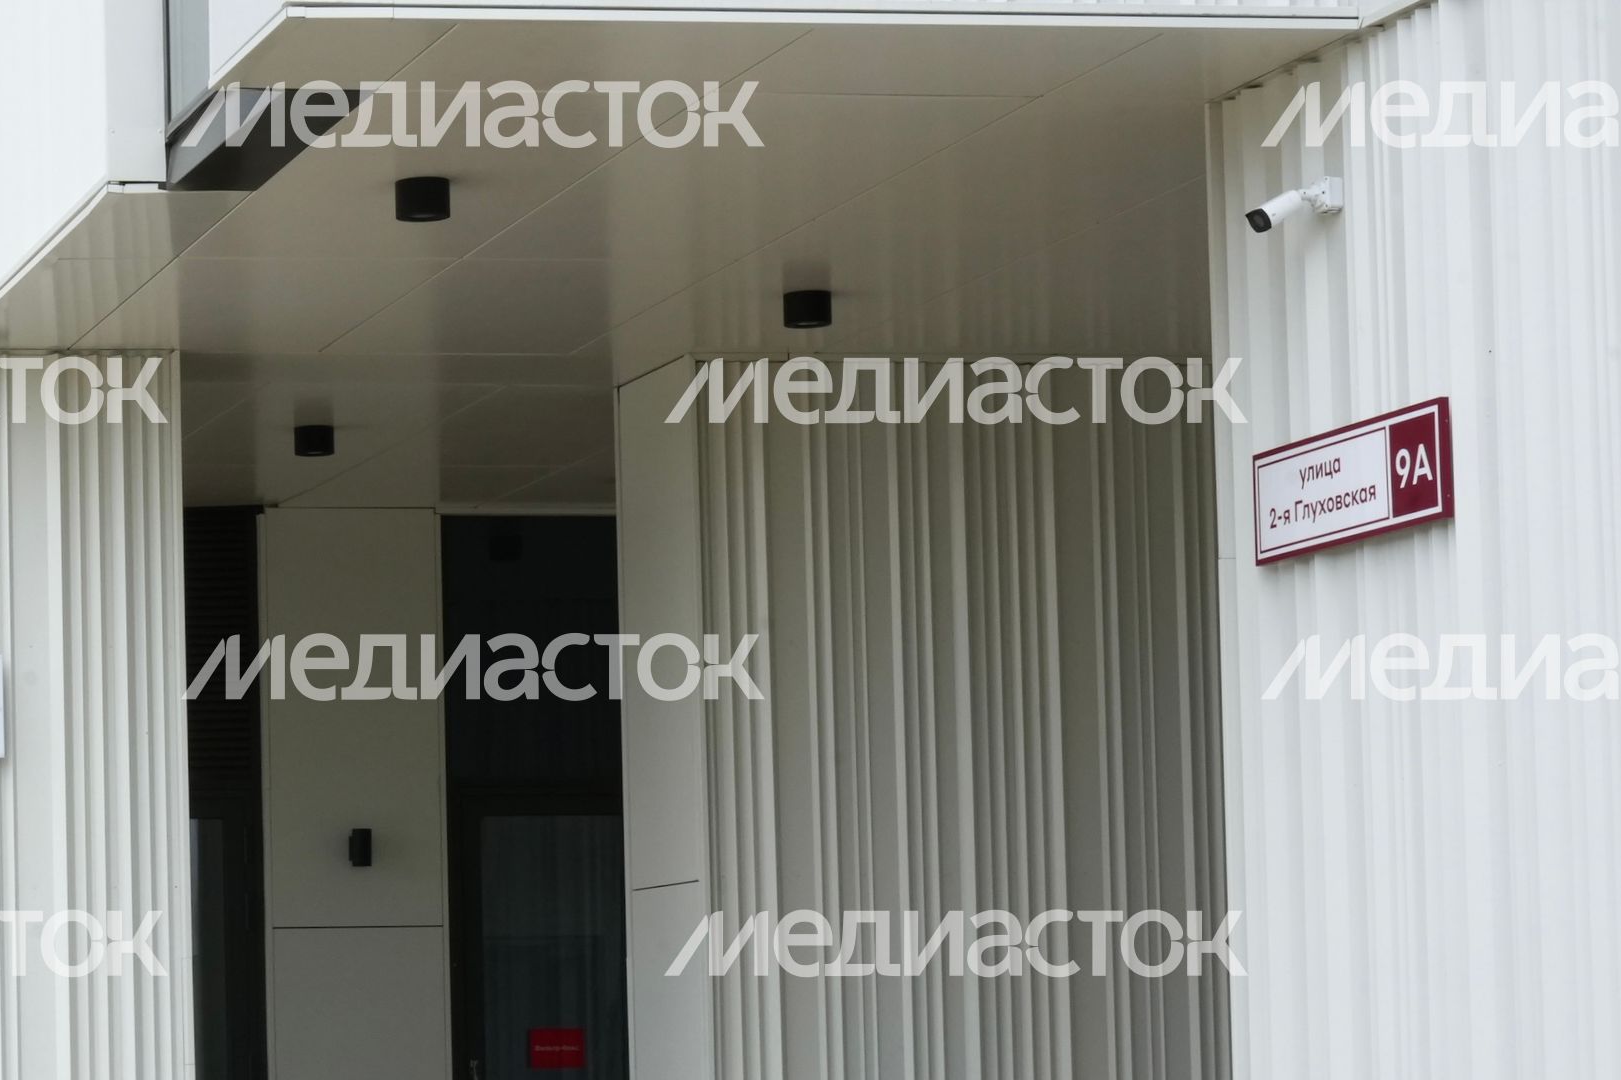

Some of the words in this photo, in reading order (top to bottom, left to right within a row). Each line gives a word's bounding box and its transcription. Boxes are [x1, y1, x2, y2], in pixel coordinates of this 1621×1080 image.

[1299, 456, 1342, 488] улица
[1394, 443, 1433, 489] 9А
[1269, 508, 1291, 530] 2-я
[1294, 484, 1378, 523] Глуховская
